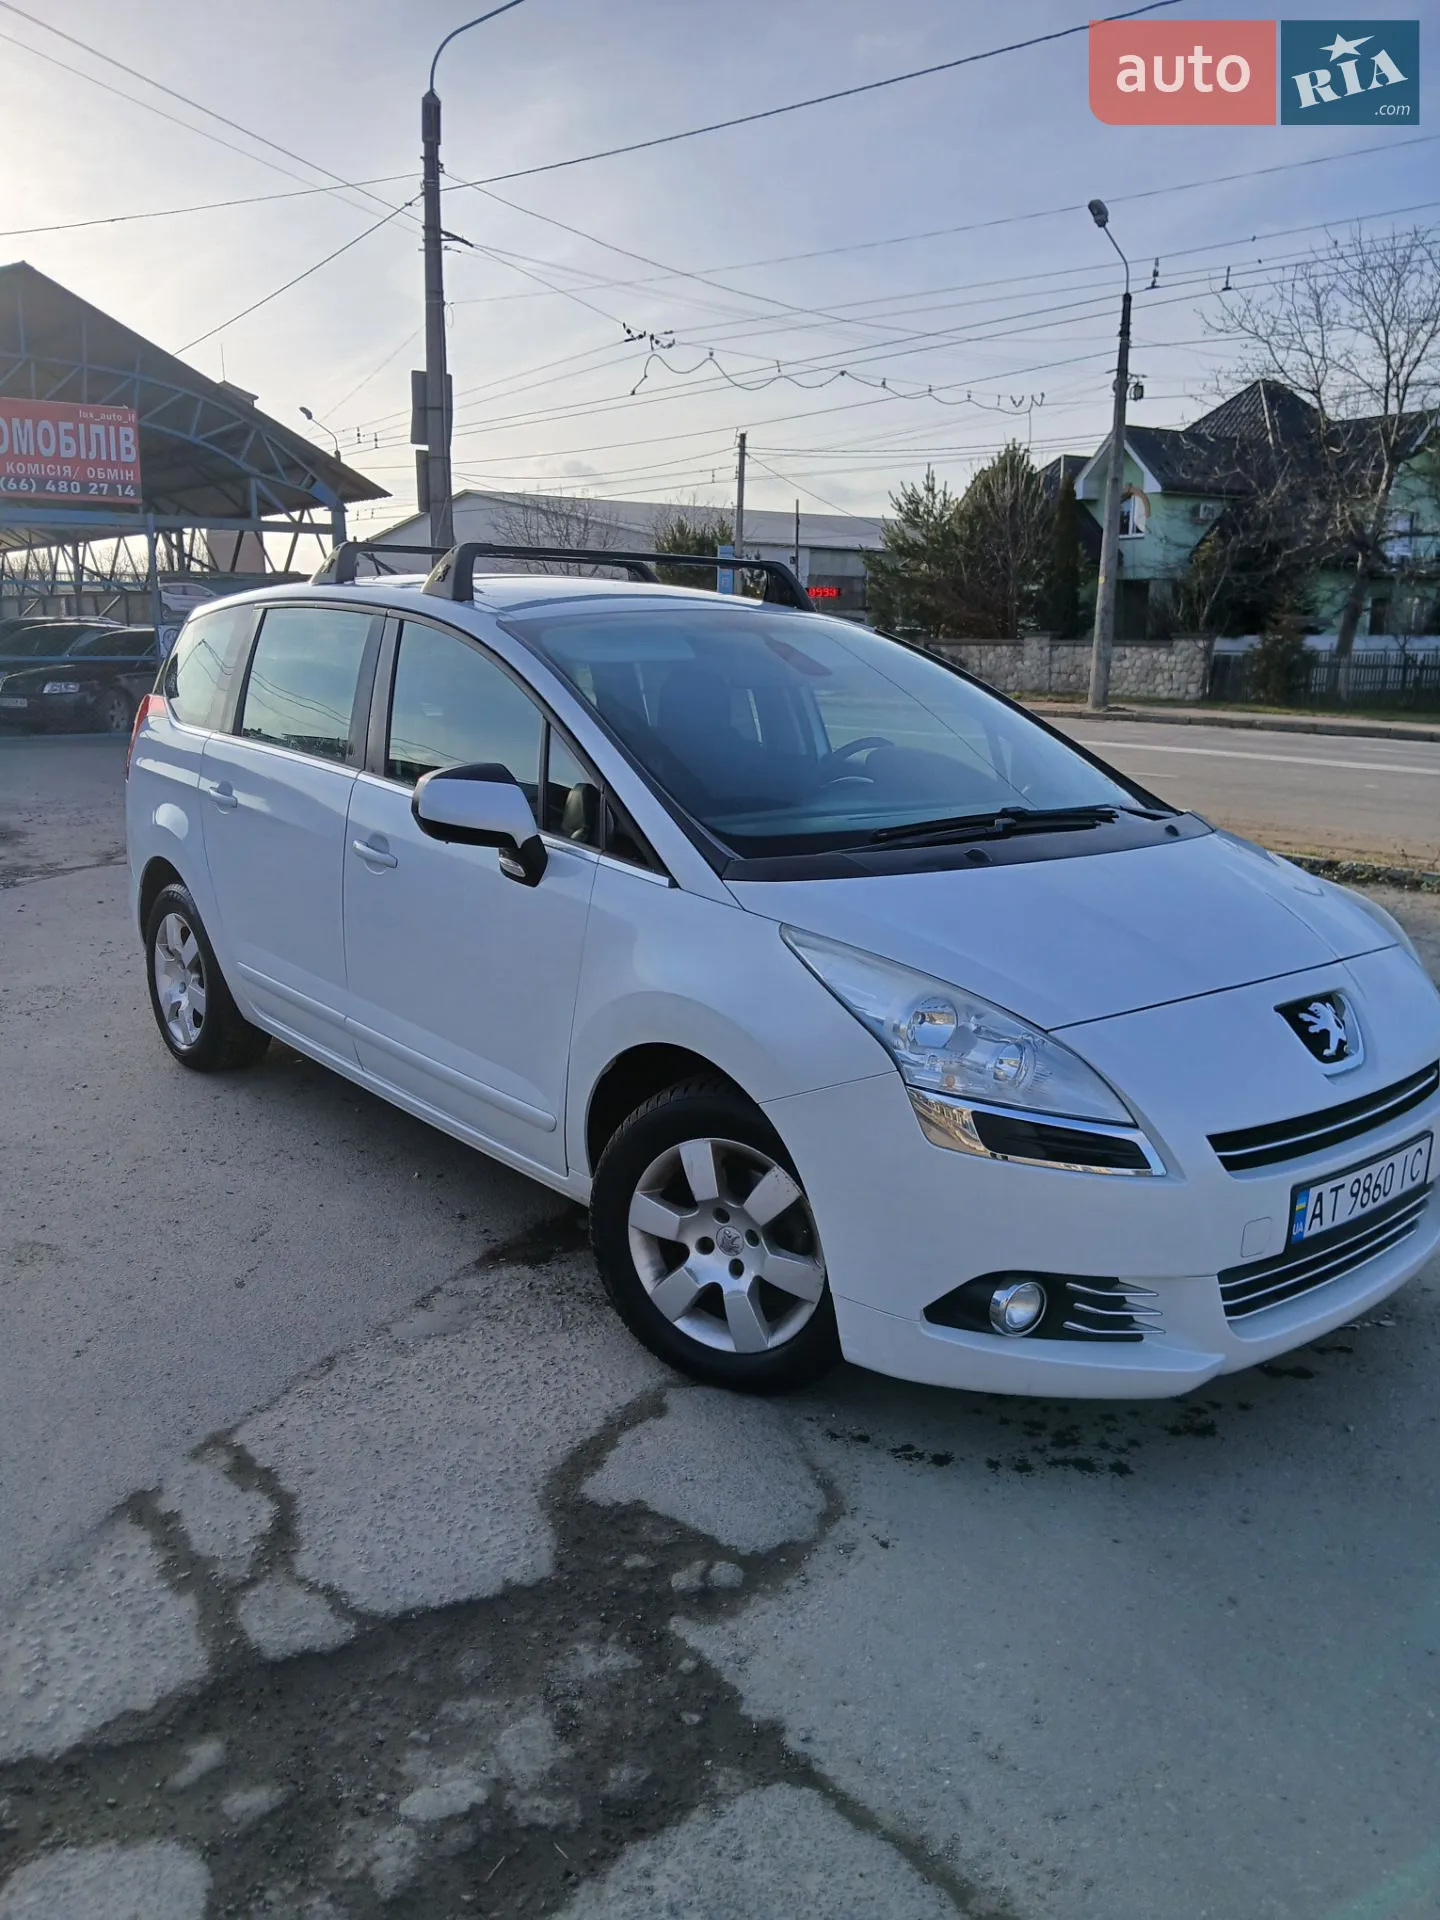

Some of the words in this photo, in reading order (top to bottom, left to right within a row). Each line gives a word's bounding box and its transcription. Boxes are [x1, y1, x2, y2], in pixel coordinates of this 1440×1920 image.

[86, 467, 134, 481] ОБМІН
[45, 479, 81, 493] 480
[88, 482, 109, 495] 27
[116, 483, 135, 497] 14
[1307, 1183, 1346, 1231] AT
[1347, 1161, 1395, 1216] 9860
[1400, 1147, 1423, 1188] IC
[1292, 1220, 1304, 1236] UA
